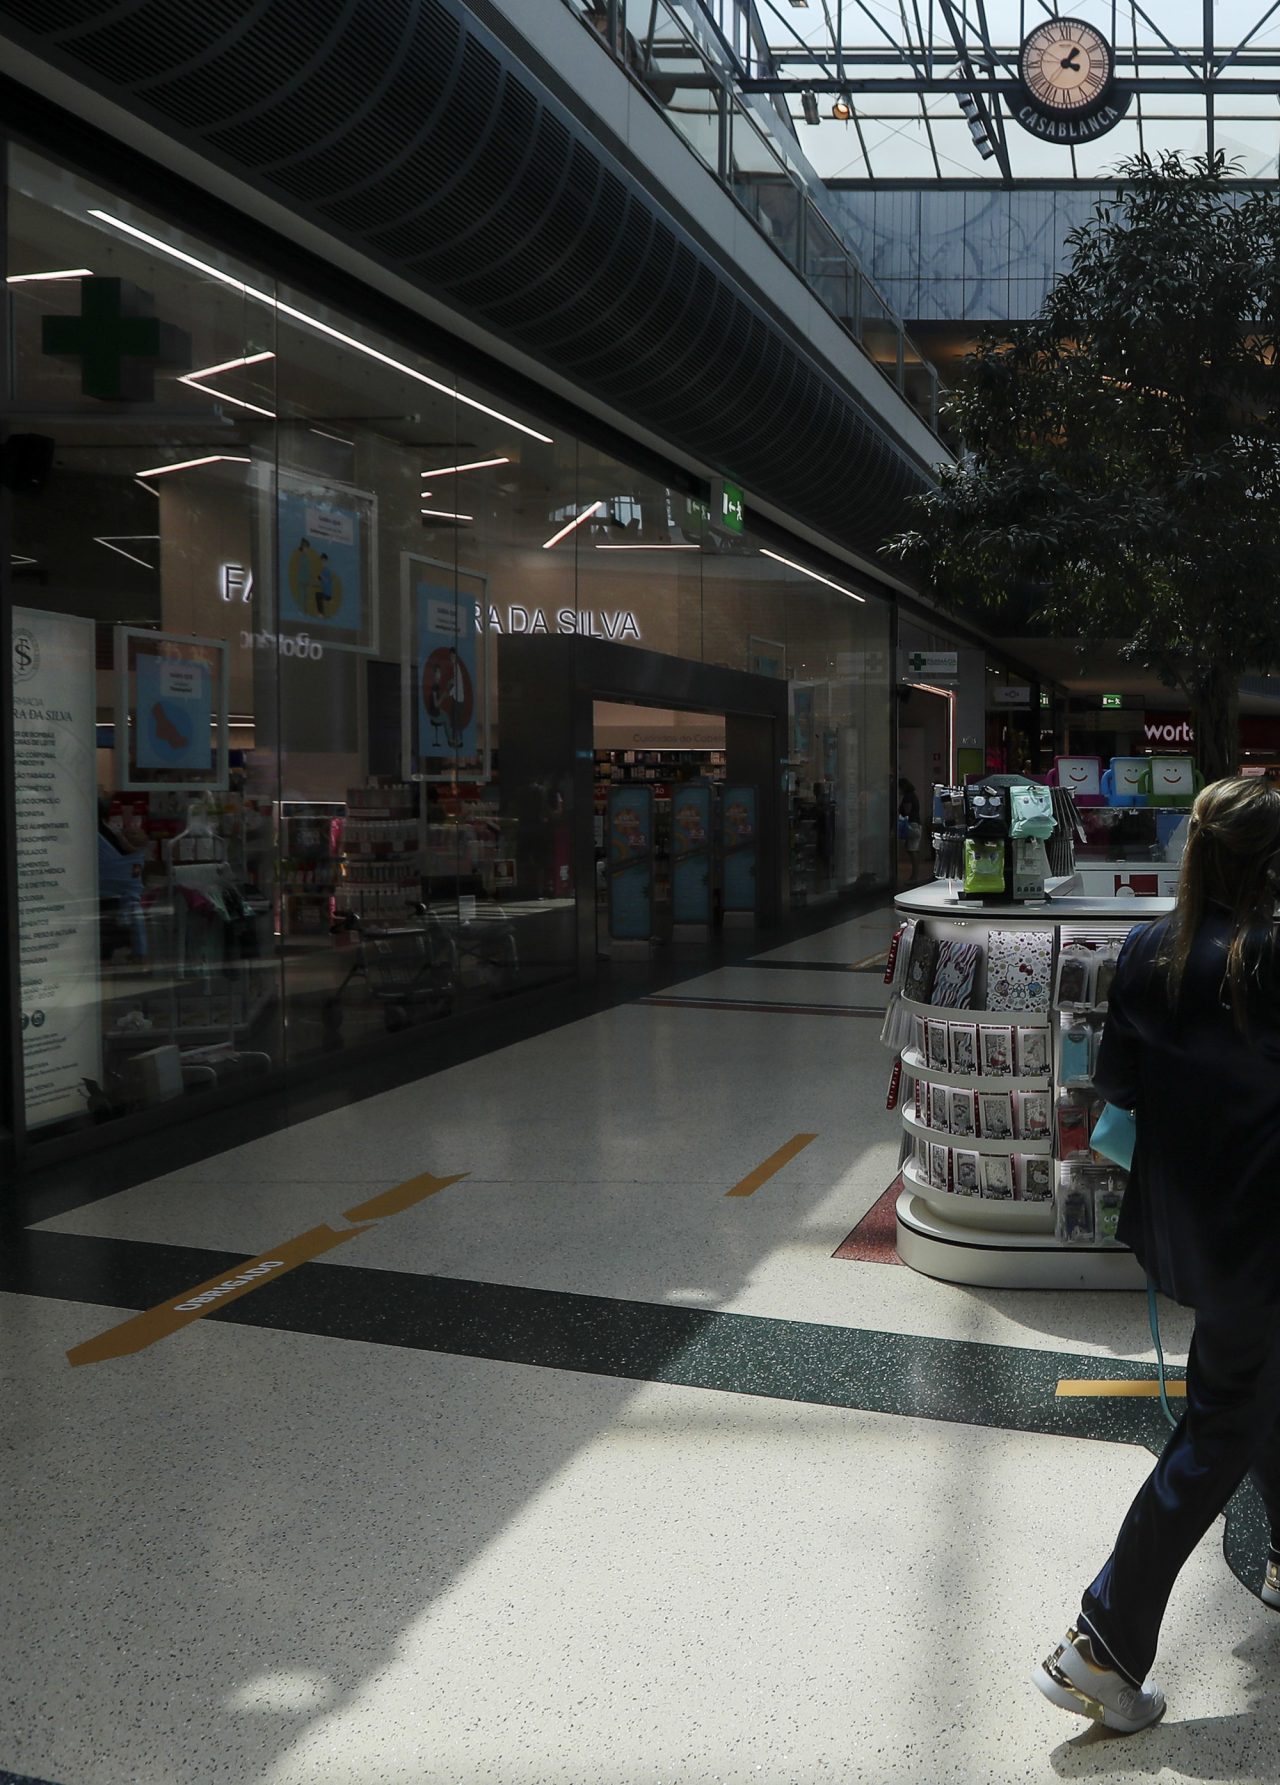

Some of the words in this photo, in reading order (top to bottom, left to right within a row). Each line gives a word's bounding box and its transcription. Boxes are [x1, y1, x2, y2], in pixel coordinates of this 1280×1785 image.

[1019, 106, 1118, 137] CASABLANCA
[508, 606, 549, 635] DA
[557, 608, 642, 640] SILVA
[172, 1260, 284, 1312] OBRIGADO
